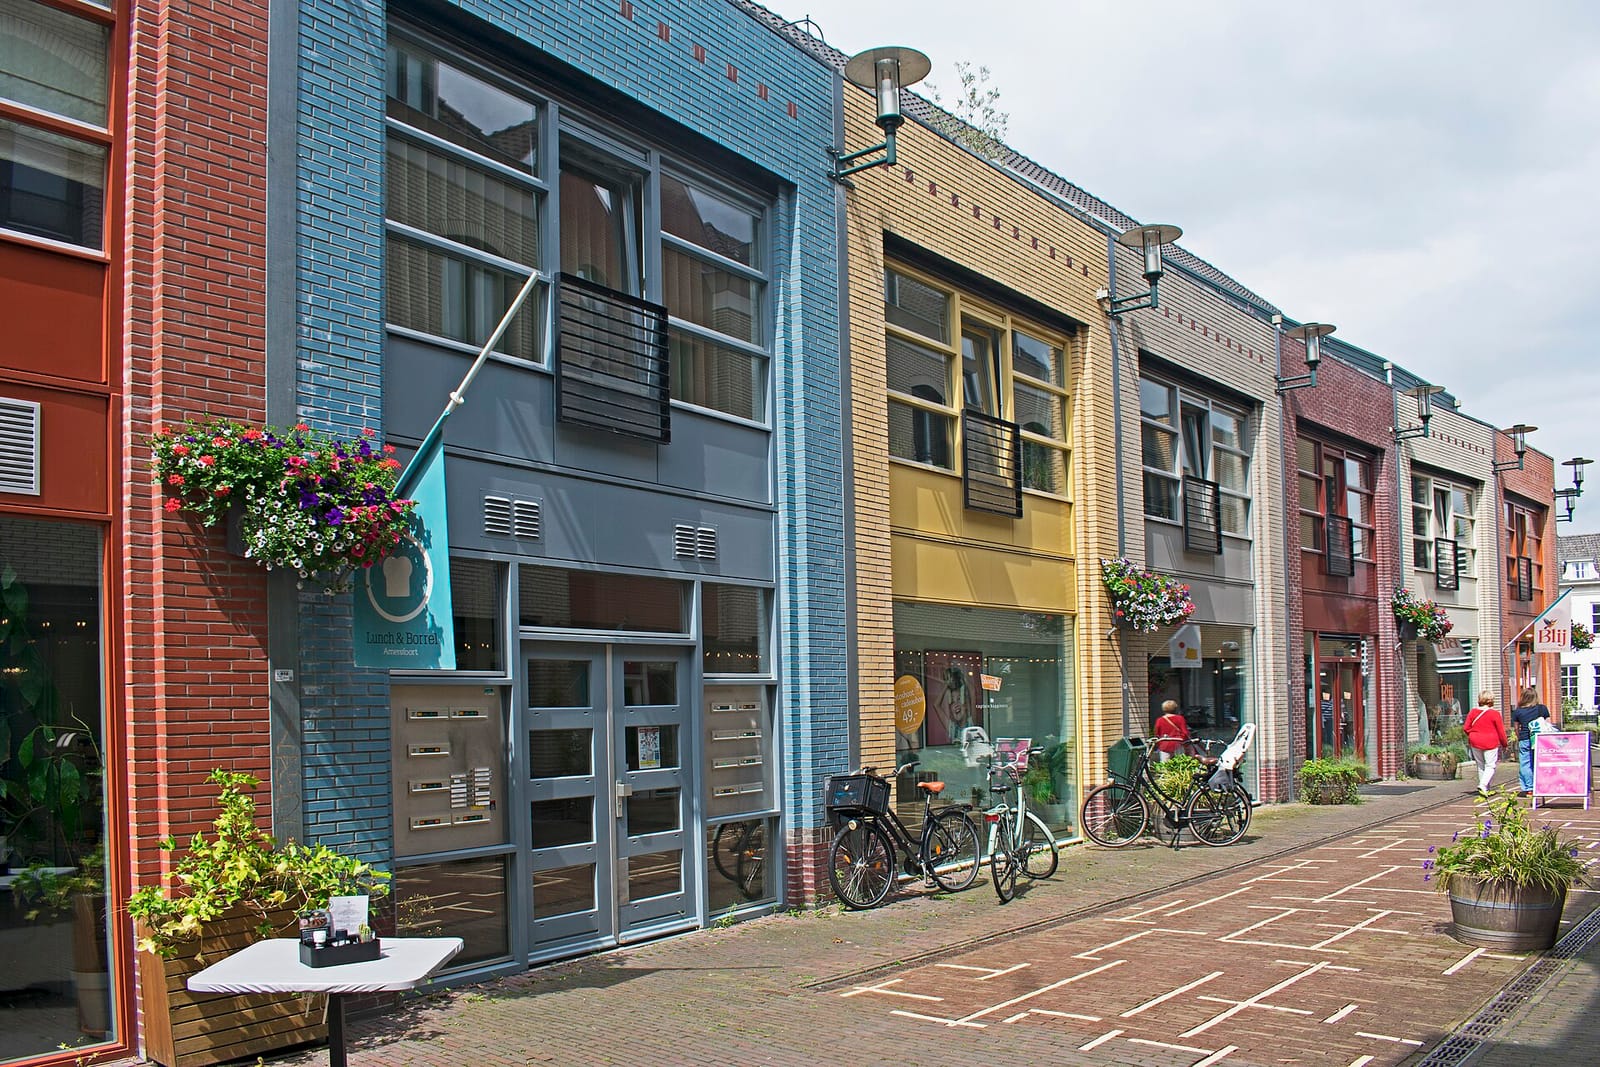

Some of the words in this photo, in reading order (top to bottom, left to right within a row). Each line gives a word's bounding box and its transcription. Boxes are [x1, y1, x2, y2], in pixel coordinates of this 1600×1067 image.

[367, 632, 396, 645] Lunch
[397, 633, 403, 645] &
[406, 633, 438, 645] Borrel
[1538, 629, 1567, 647] Blij
